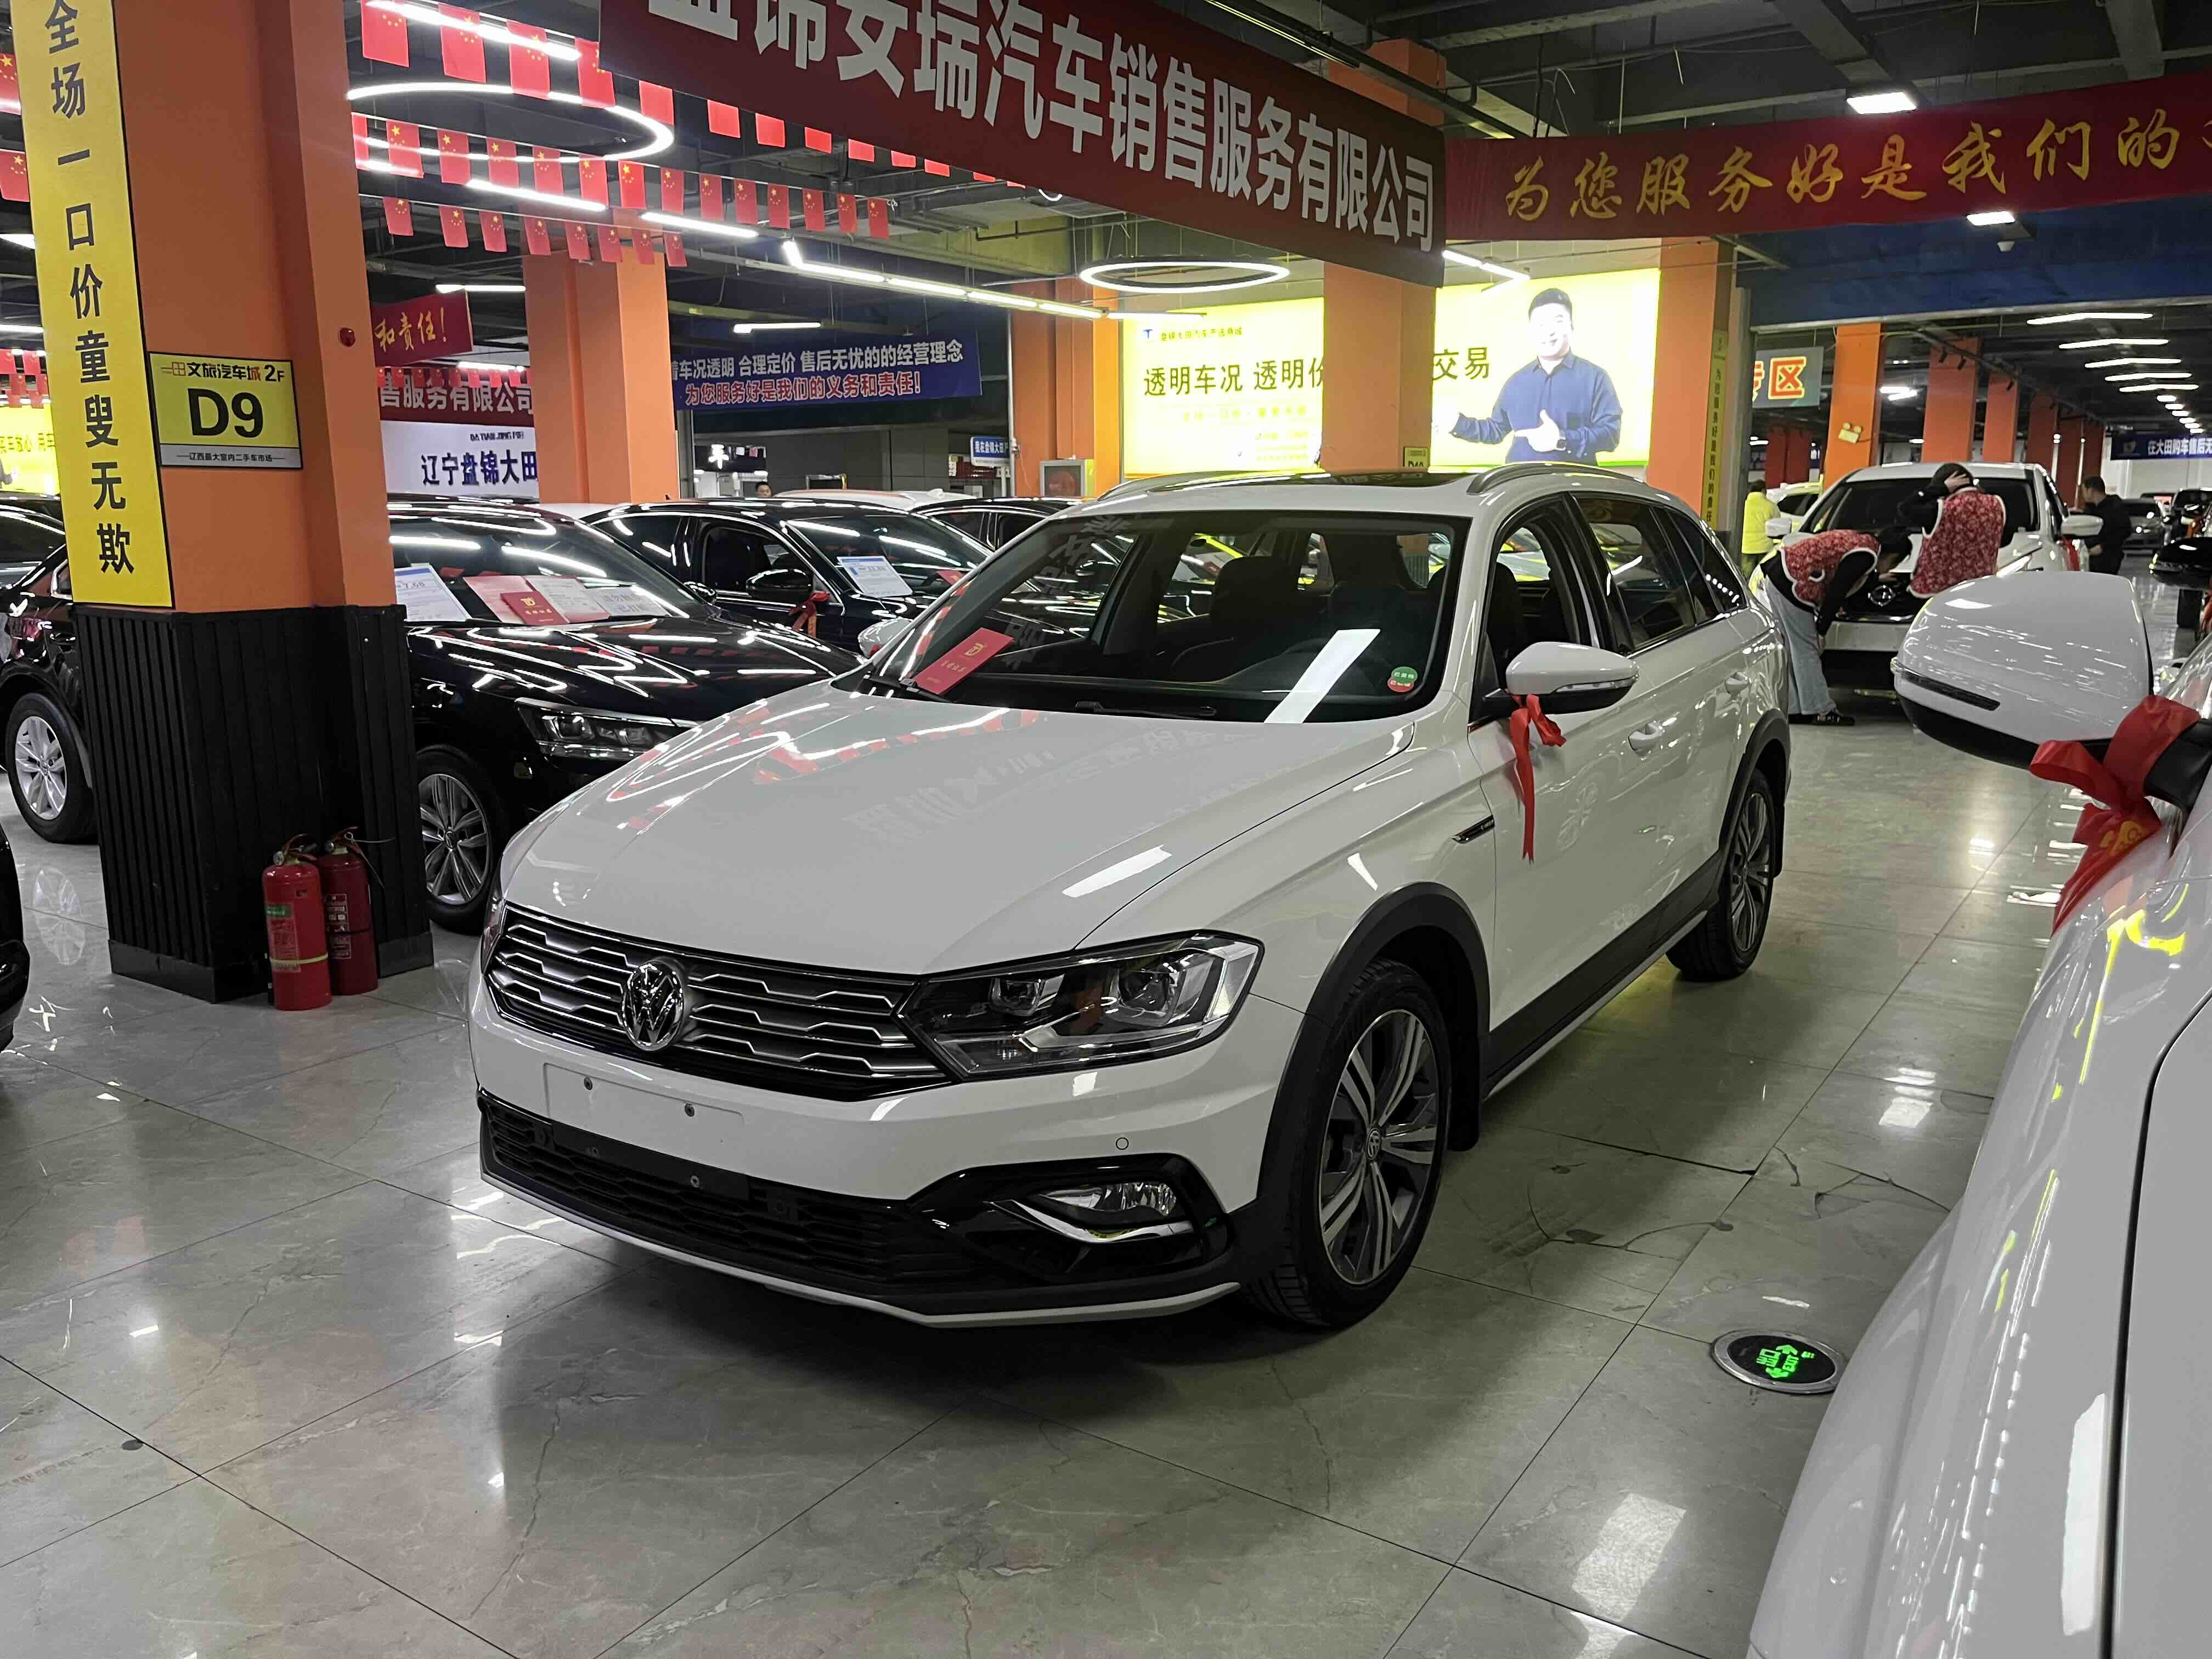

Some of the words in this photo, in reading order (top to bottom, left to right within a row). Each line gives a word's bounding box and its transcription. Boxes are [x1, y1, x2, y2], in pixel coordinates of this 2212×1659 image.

[649, 0, 1433, 252] 安瑞汽车销售服务有限公司
[1506, 109, 2212, 221] 为您服务好是我们的
[44, 0, 134, 575] 全场一口价童叟无欺
[187, 362, 262, 381] 文旅汽车城
[264, 364, 285, 382] 2F
[739, 351, 795, 377] 合理定价
[800, 338, 964, 373] 售后无忧的的经营理念
[1144, 364, 1243, 396] 透明车况
[1432, 347, 1489, 380] 交易
[187, 388, 263, 438] D9
[685, 371, 921, 406] 为您服务好是我们的义务和责任!
[421, 449, 538, 486] 辽宁盘锦大田
